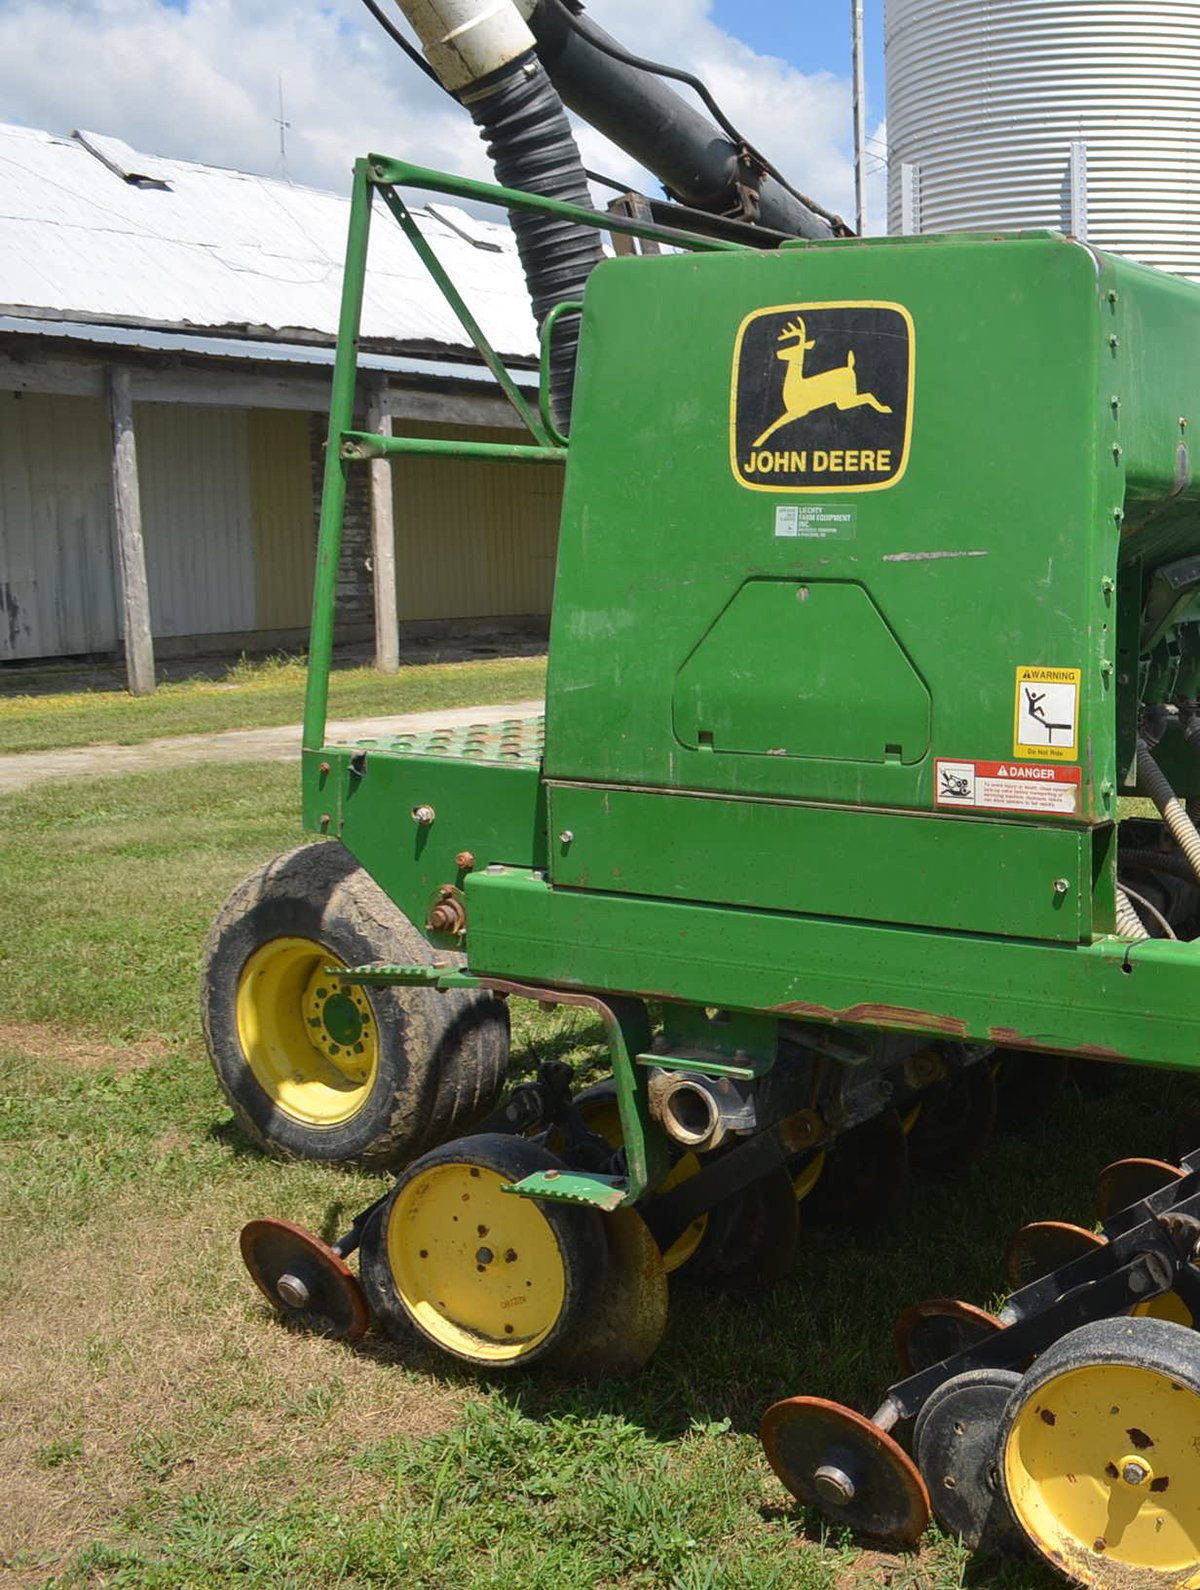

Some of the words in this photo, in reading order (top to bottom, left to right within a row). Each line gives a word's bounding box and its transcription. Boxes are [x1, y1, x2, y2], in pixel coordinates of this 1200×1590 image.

[743, 450, 807, 474] JOHN
[812, 449, 892, 473] DEERE
[1031, 670, 1075, 681] WARNING
[1038, 748, 1048, 756] Not
[1050, 749, 1064, 757] Ride
[1009, 766, 1055, 780] DANGER
